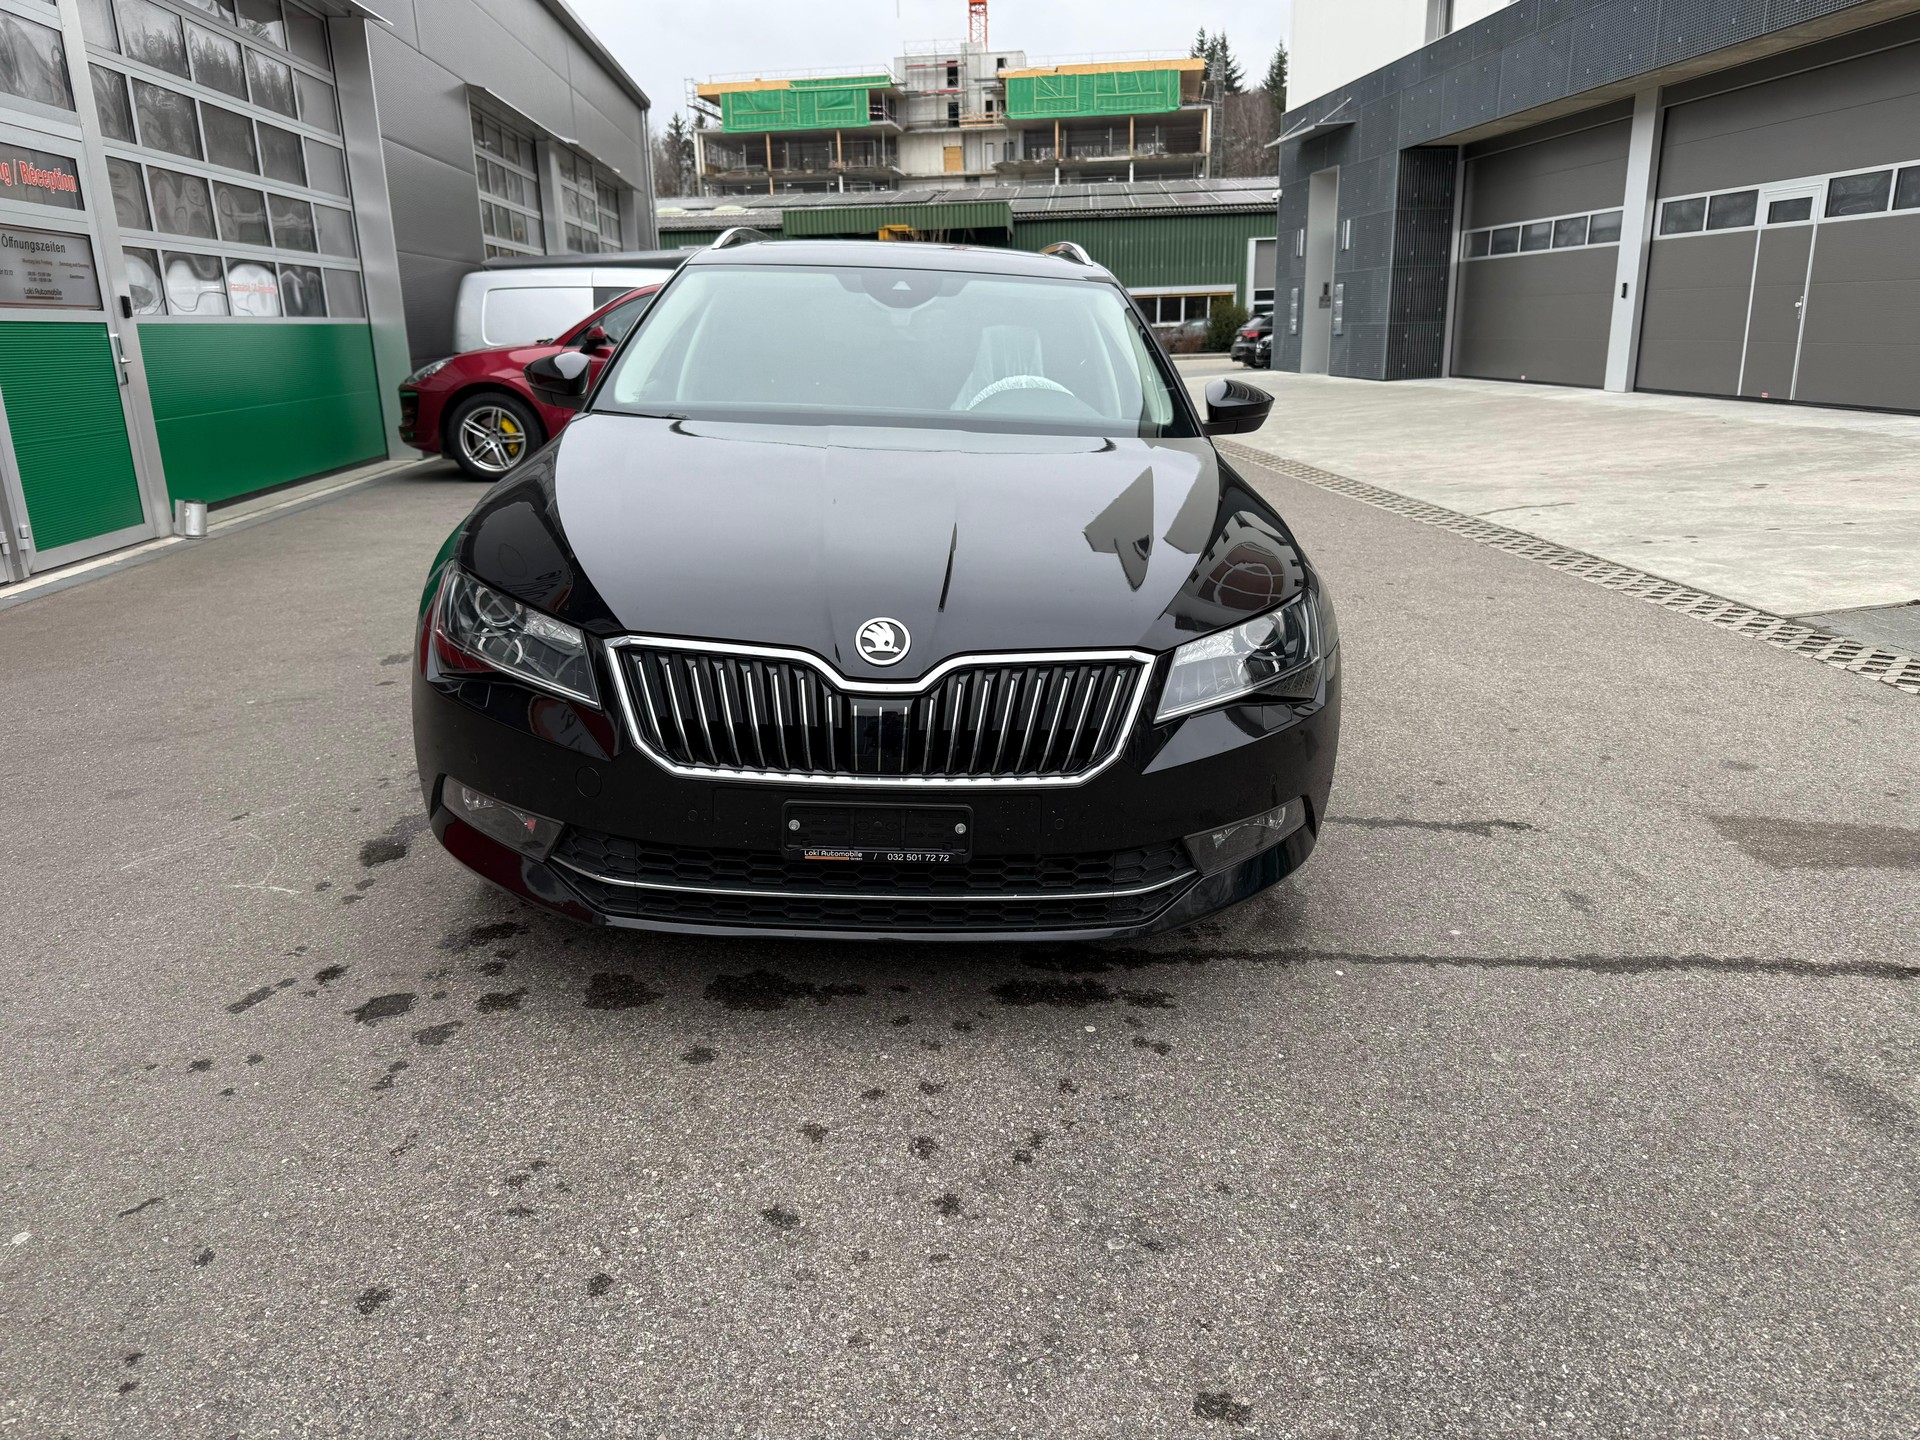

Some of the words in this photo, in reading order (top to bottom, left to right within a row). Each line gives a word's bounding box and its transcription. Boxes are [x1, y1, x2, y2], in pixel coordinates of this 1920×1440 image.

[13, 159, 18, 185] /
[19, 161, 77, 194] Réception
[1, 233, 66, 254] Öffnungszeiten
[35, 287, 63, 297] Automobile
[820, 850, 863, 858] Automobile
[887, 853, 904, 861] 032
[906, 853, 922, 861] 501
[925, 854, 936, 862] 72
[938, 854, 950, 862] 72
